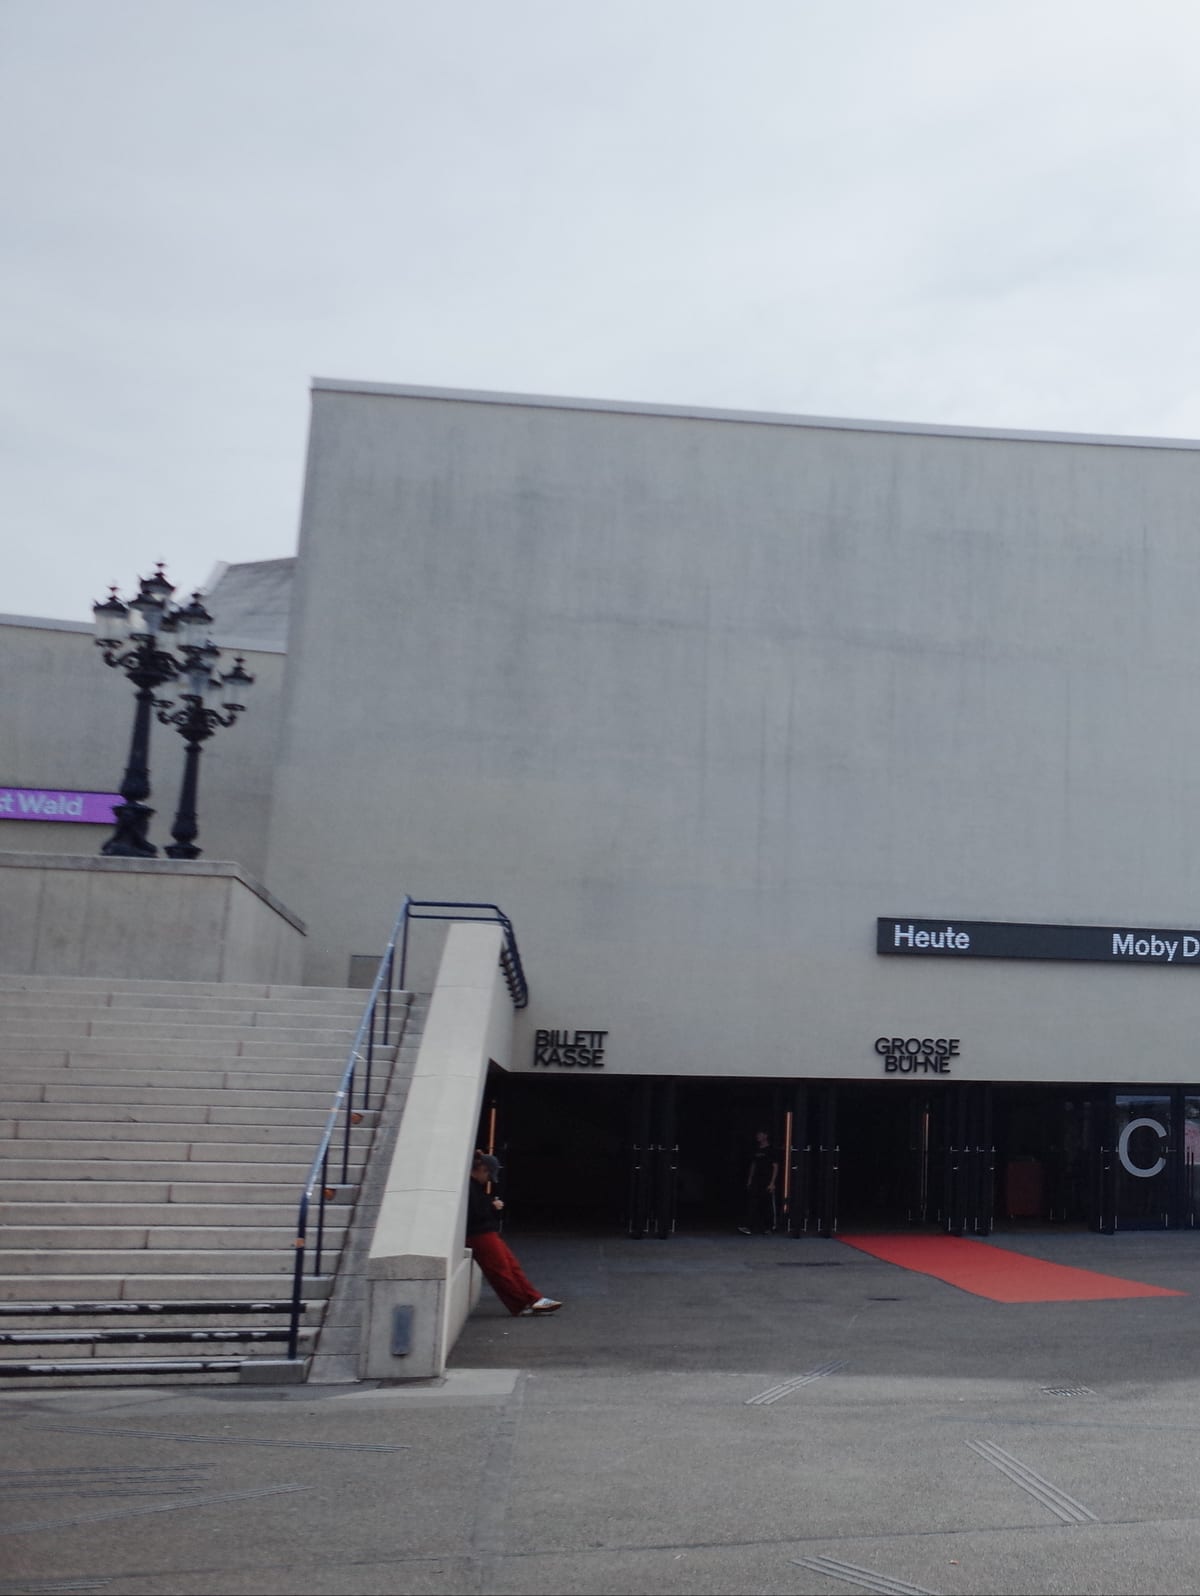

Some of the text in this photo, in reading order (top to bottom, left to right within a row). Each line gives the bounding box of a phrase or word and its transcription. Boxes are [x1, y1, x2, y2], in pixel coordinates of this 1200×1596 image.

[17, 792, 84, 816] Wald
[894, 924, 970, 949] Heute
[1112, 933, 1178, 961] Moby
[535, 1029, 609, 1048] BILLETT
[874, 1037, 961, 1056] GROSSE
[533, 1048, 605, 1067] KASSE
[885, 1055, 951, 1073] BÜHNE
[1118, 1117, 1168, 1178] C
